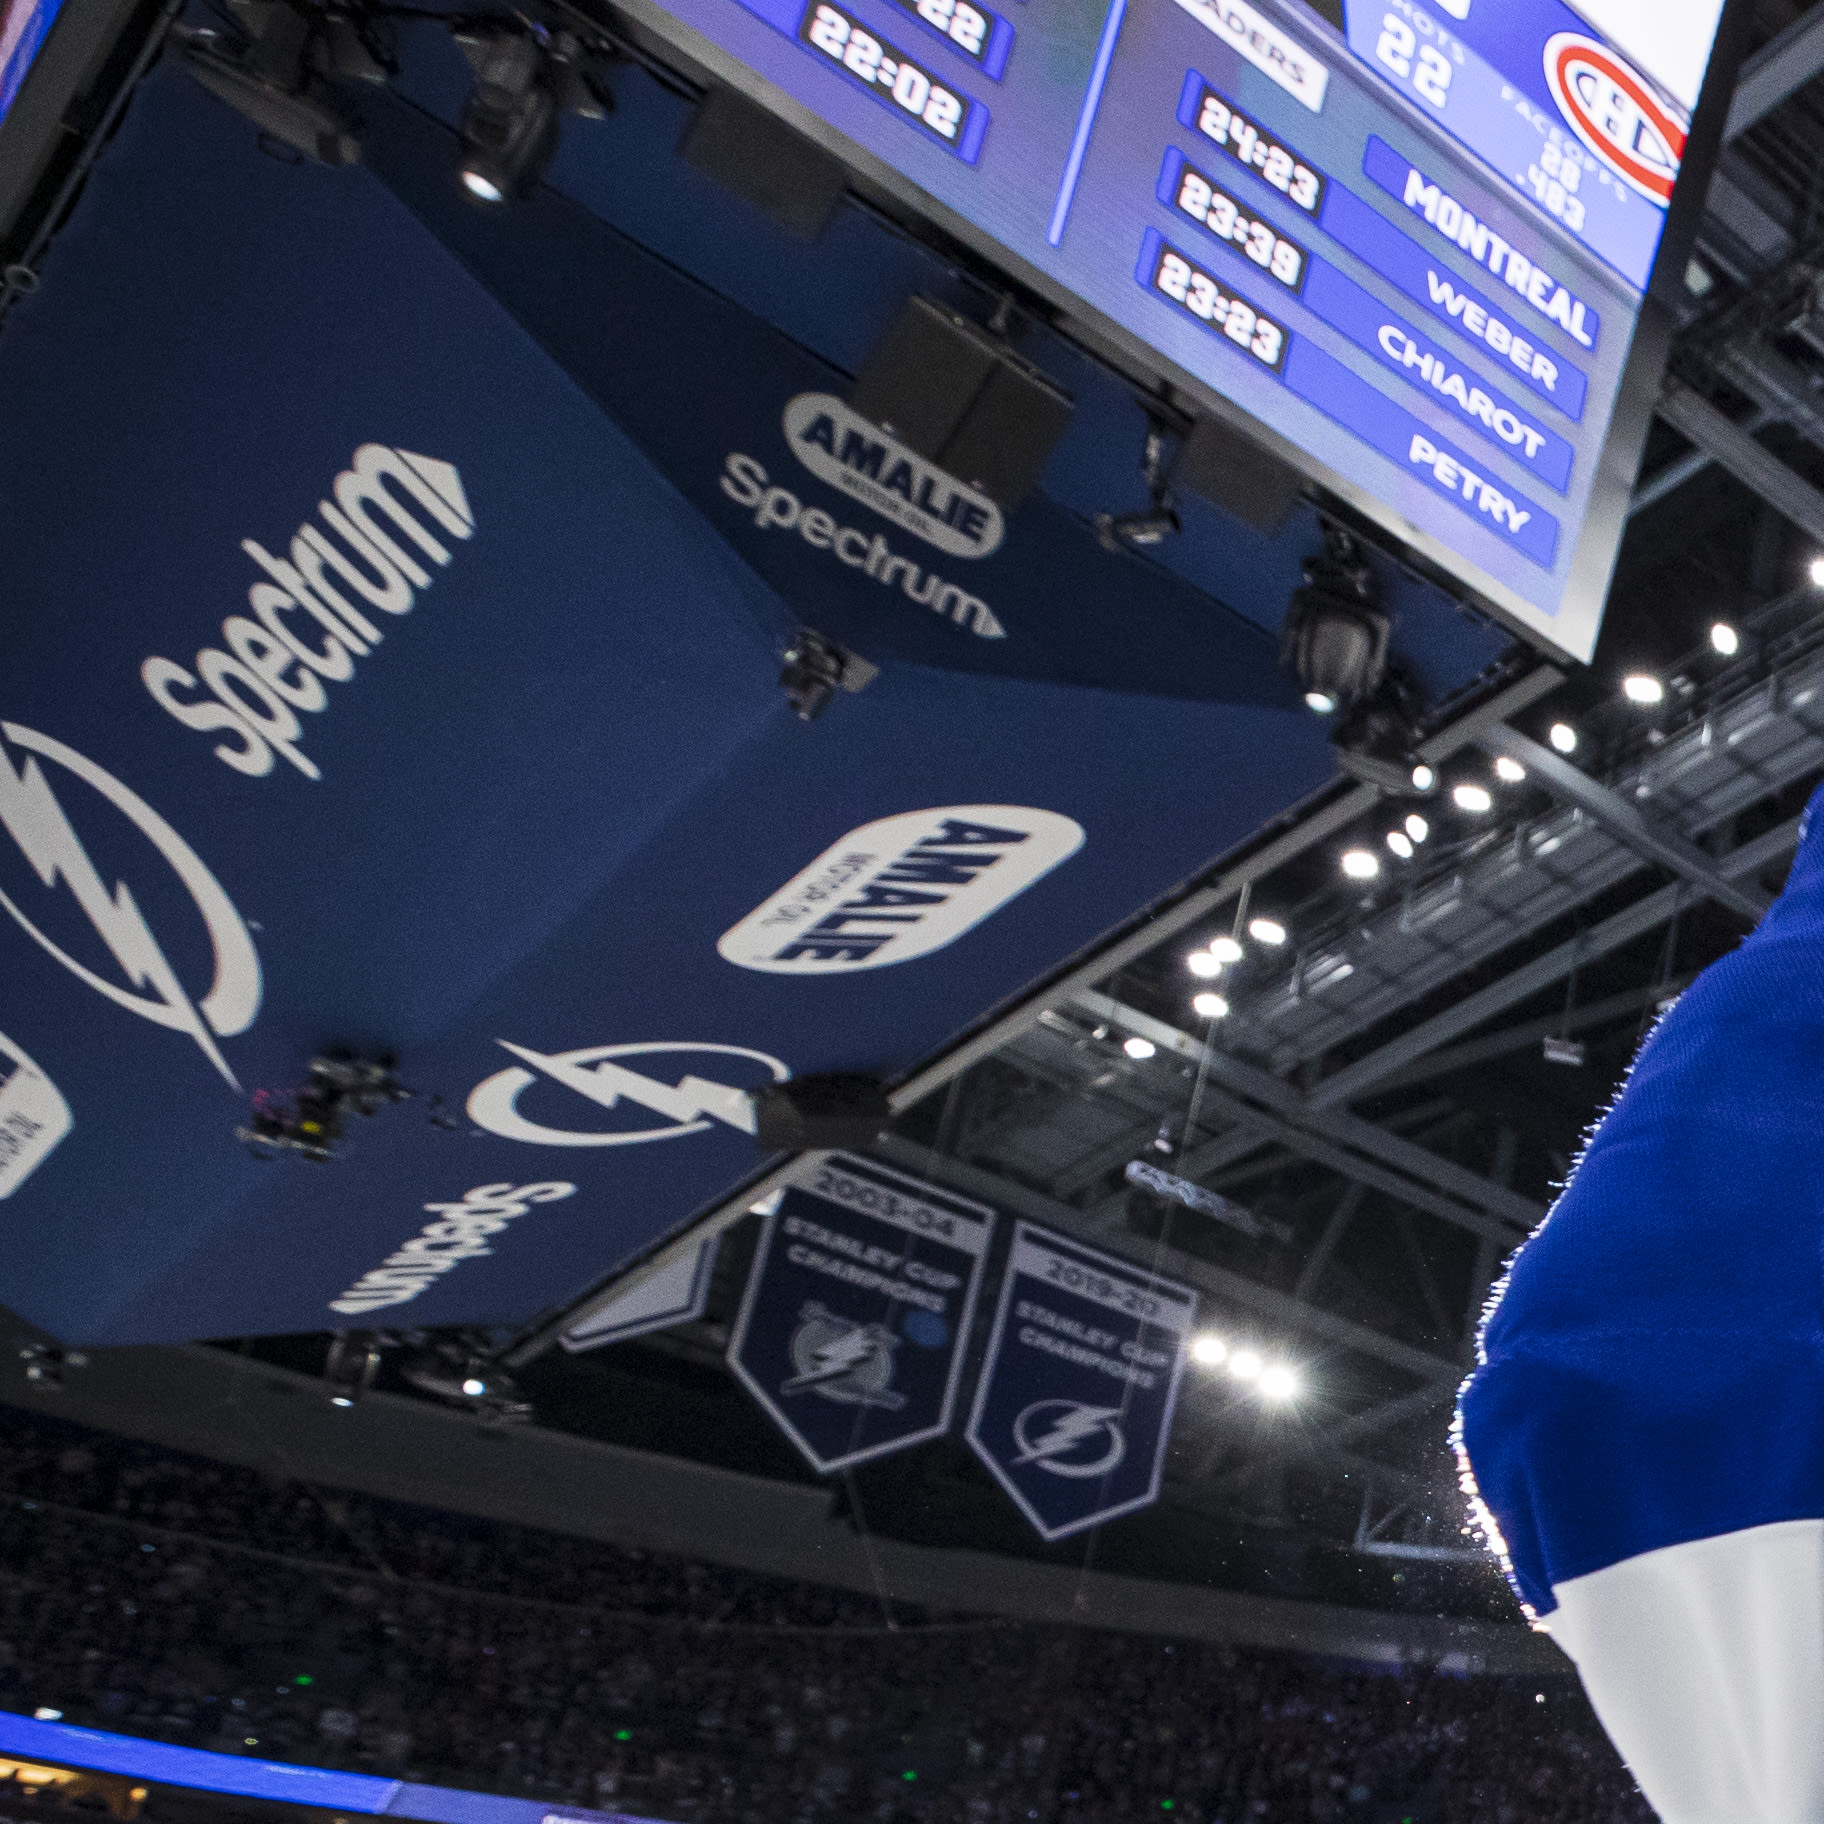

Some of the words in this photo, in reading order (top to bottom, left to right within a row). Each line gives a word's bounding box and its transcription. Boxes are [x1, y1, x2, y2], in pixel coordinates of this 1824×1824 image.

[809, 4, 962, 140] 22:02
[1376, 12, 1452, 109] 22
[1199, 96, 1319, 211] 24:23
[1179, 173, 1301, 286] 23:39
[1403, 169, 1593, 348] MONTREAL
[1157, 253, 1281, 365] 23:23
[1427, 270, 1559, 391] WEBER
[1377, 325, 1546, 460] CHIAROT
[802, 411, 989, 544] AMALIE
[1410, 434, 1530, 534] PETRY
[720, 452, 1003, 638] Spectrum
[140, 443, 473, 781] Spectrum
[774, 817, 1031, 961] AMALIE
[328, 1181, 577, 1315] Spectrum
